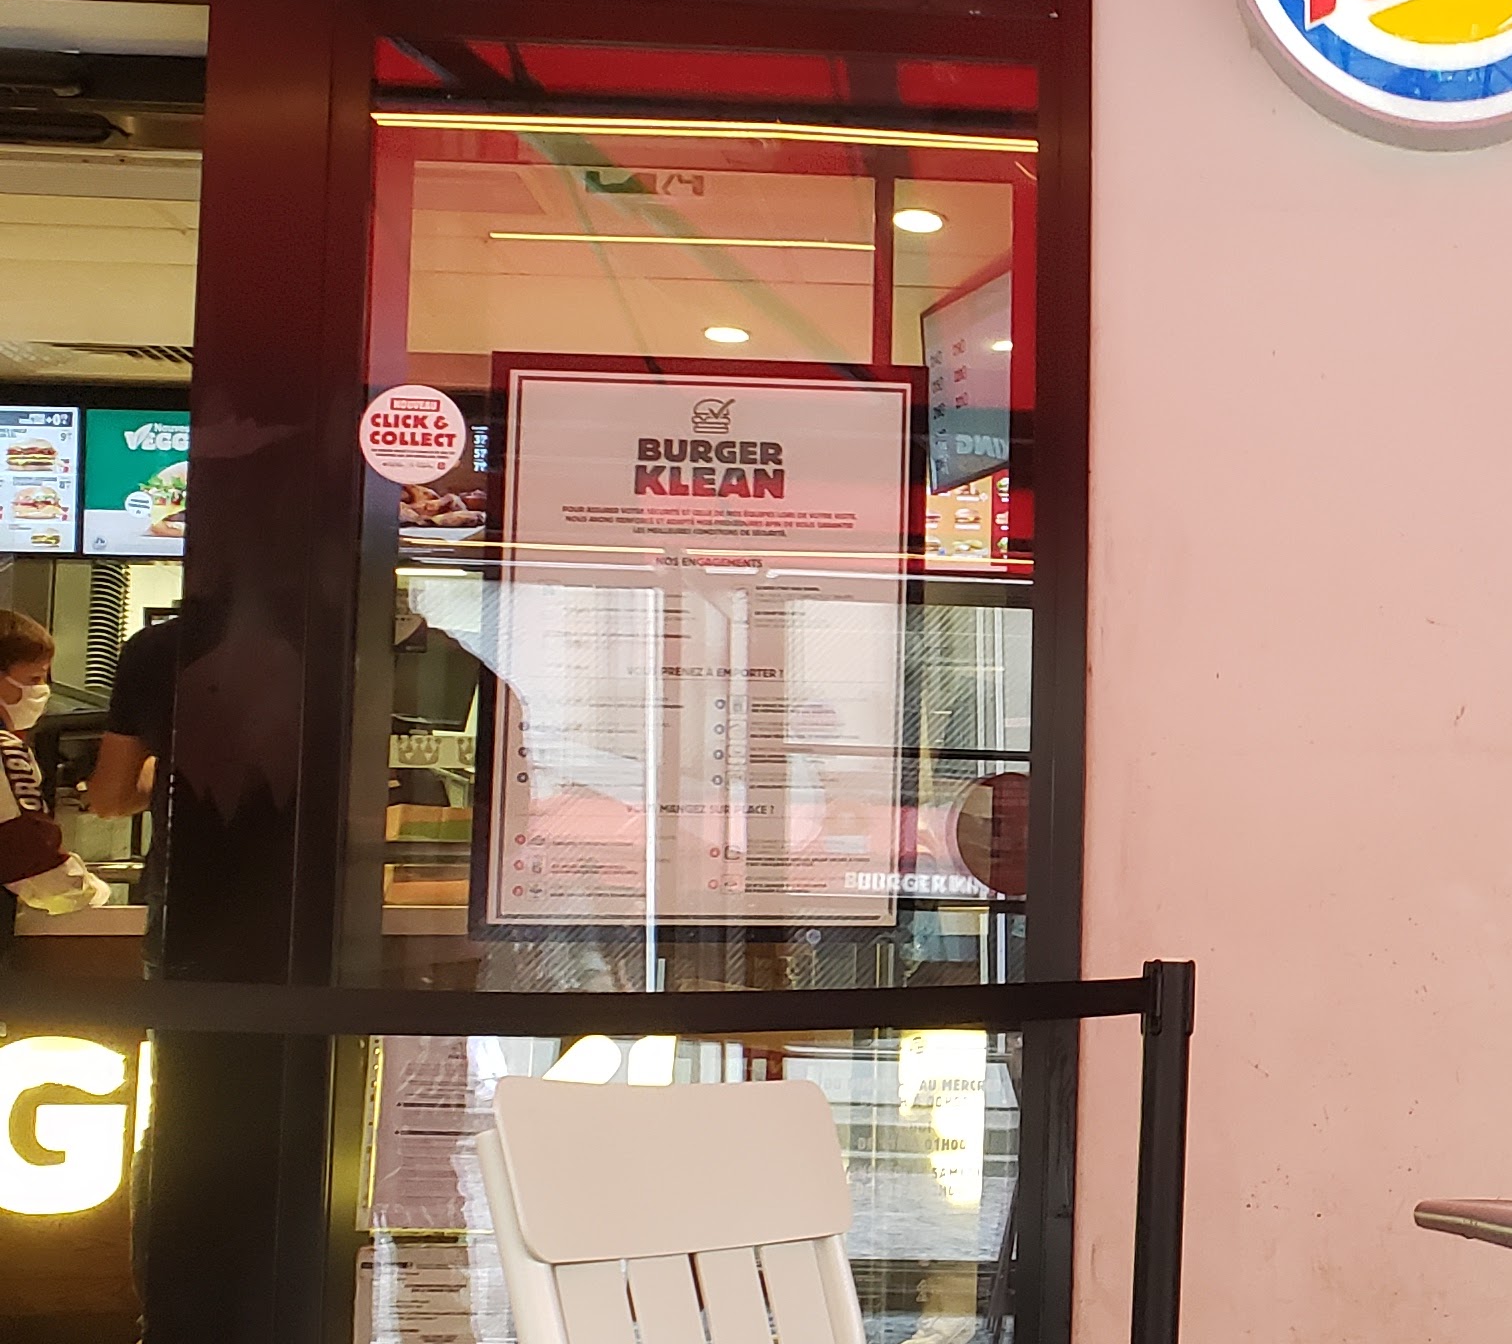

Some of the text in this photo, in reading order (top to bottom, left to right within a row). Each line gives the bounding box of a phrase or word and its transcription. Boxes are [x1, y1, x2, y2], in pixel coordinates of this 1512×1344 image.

[370, 413, 449, 430] CLICK &
[369, 430, 457, 447] COLLECT
[638, 438, 783, 465] BURGER
[634, 465, 785, 499] KLEAN
[919, 1079, 936, 1091] AU
